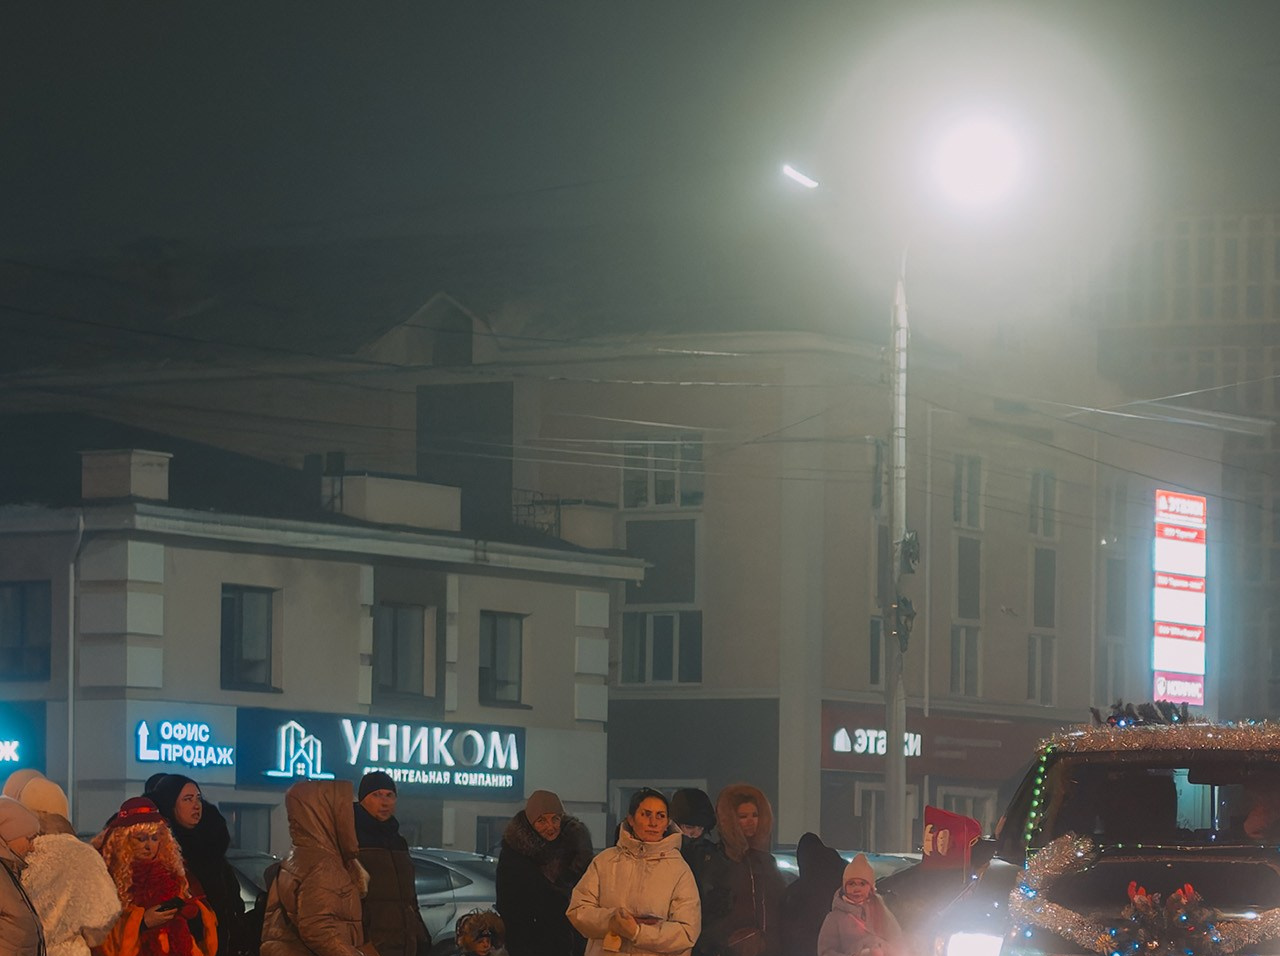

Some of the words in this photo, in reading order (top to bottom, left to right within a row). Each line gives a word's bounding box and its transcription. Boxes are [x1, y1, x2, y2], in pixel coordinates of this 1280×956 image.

[160, 721, 210, 742] ОФИС
[160, 743, 234, 767] ПРОДАЖ
[340, 718, 519, 770] УНИКОМ
[454, 772, 513, 788] КОМПАНИЯ
